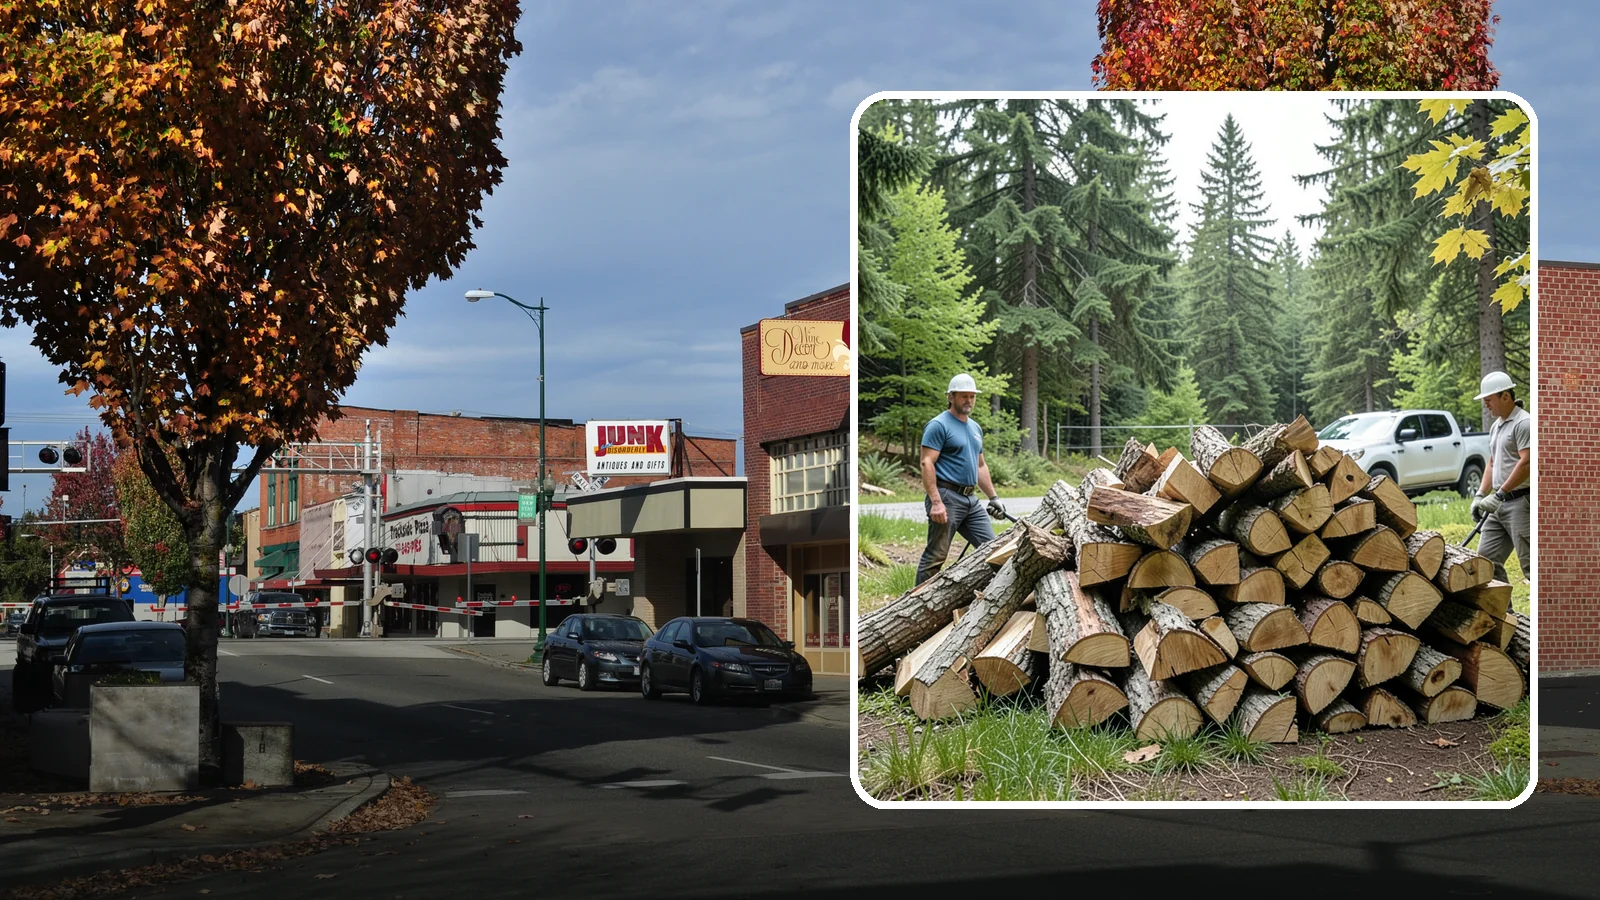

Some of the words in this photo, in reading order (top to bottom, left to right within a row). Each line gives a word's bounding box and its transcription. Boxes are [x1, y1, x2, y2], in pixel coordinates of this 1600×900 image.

[765, 327, 831, 365] Decor
[596, 425, 665, 457] JUNK
[607, 446, 645, 454] DISORDERLY
[597, 461, 628, 470] ANTIQUES
[631, 461, 644, 470] AND
[647, 460, 665, 469] GIFTS
[390, 521, 413, 539] Trackside
[414, 519, 429, 535] Pizza
